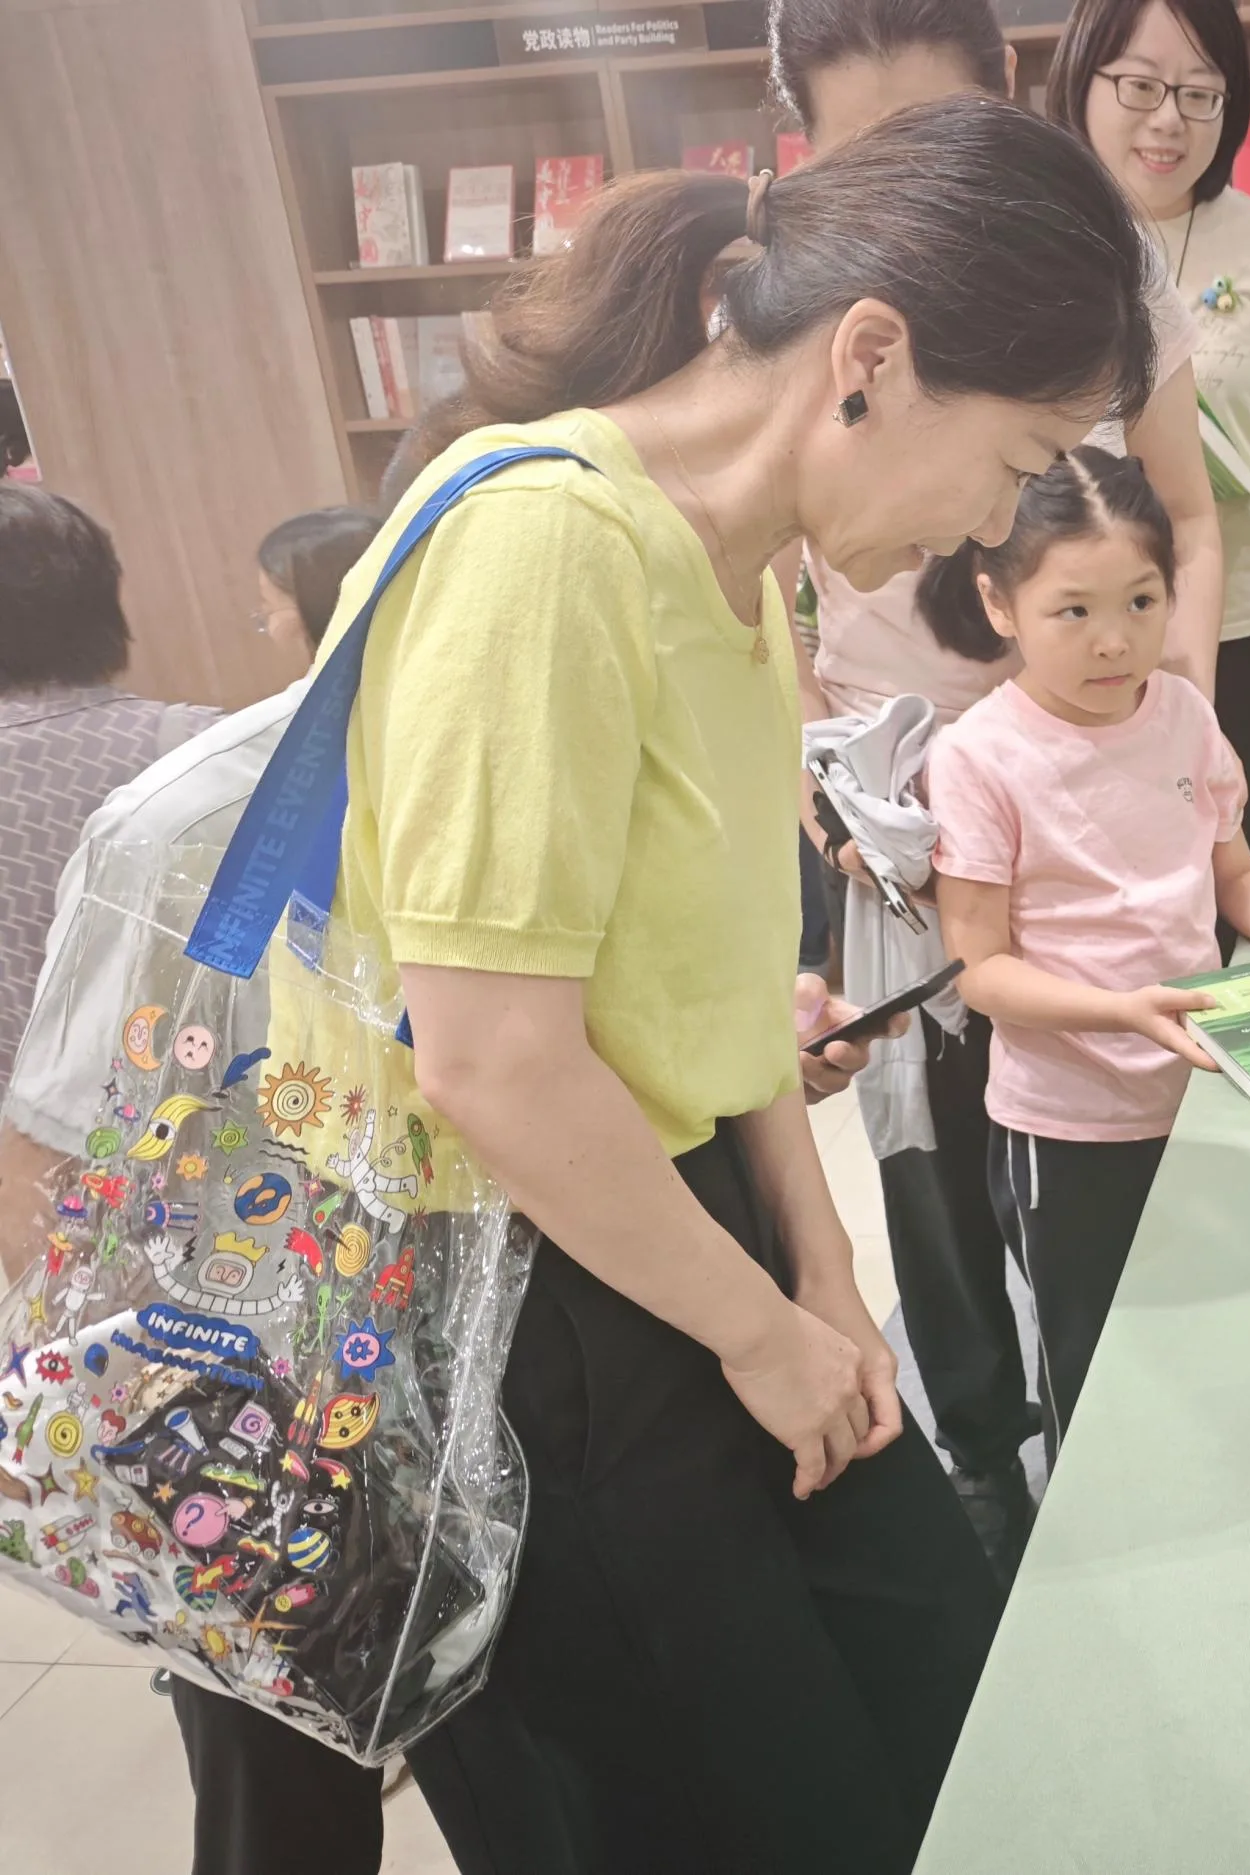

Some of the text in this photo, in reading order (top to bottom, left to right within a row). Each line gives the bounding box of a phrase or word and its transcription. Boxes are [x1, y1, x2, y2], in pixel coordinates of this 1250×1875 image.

[522, 26, 591, 52] 党政读物
[646, 20, 679, 32] Politics
[614, 33, 638, 47] Party
[638, 32, 676, 45] Building
[268, 722, 332, 832] EVENT
[147, 1311, 250, 1352] INFINITE
